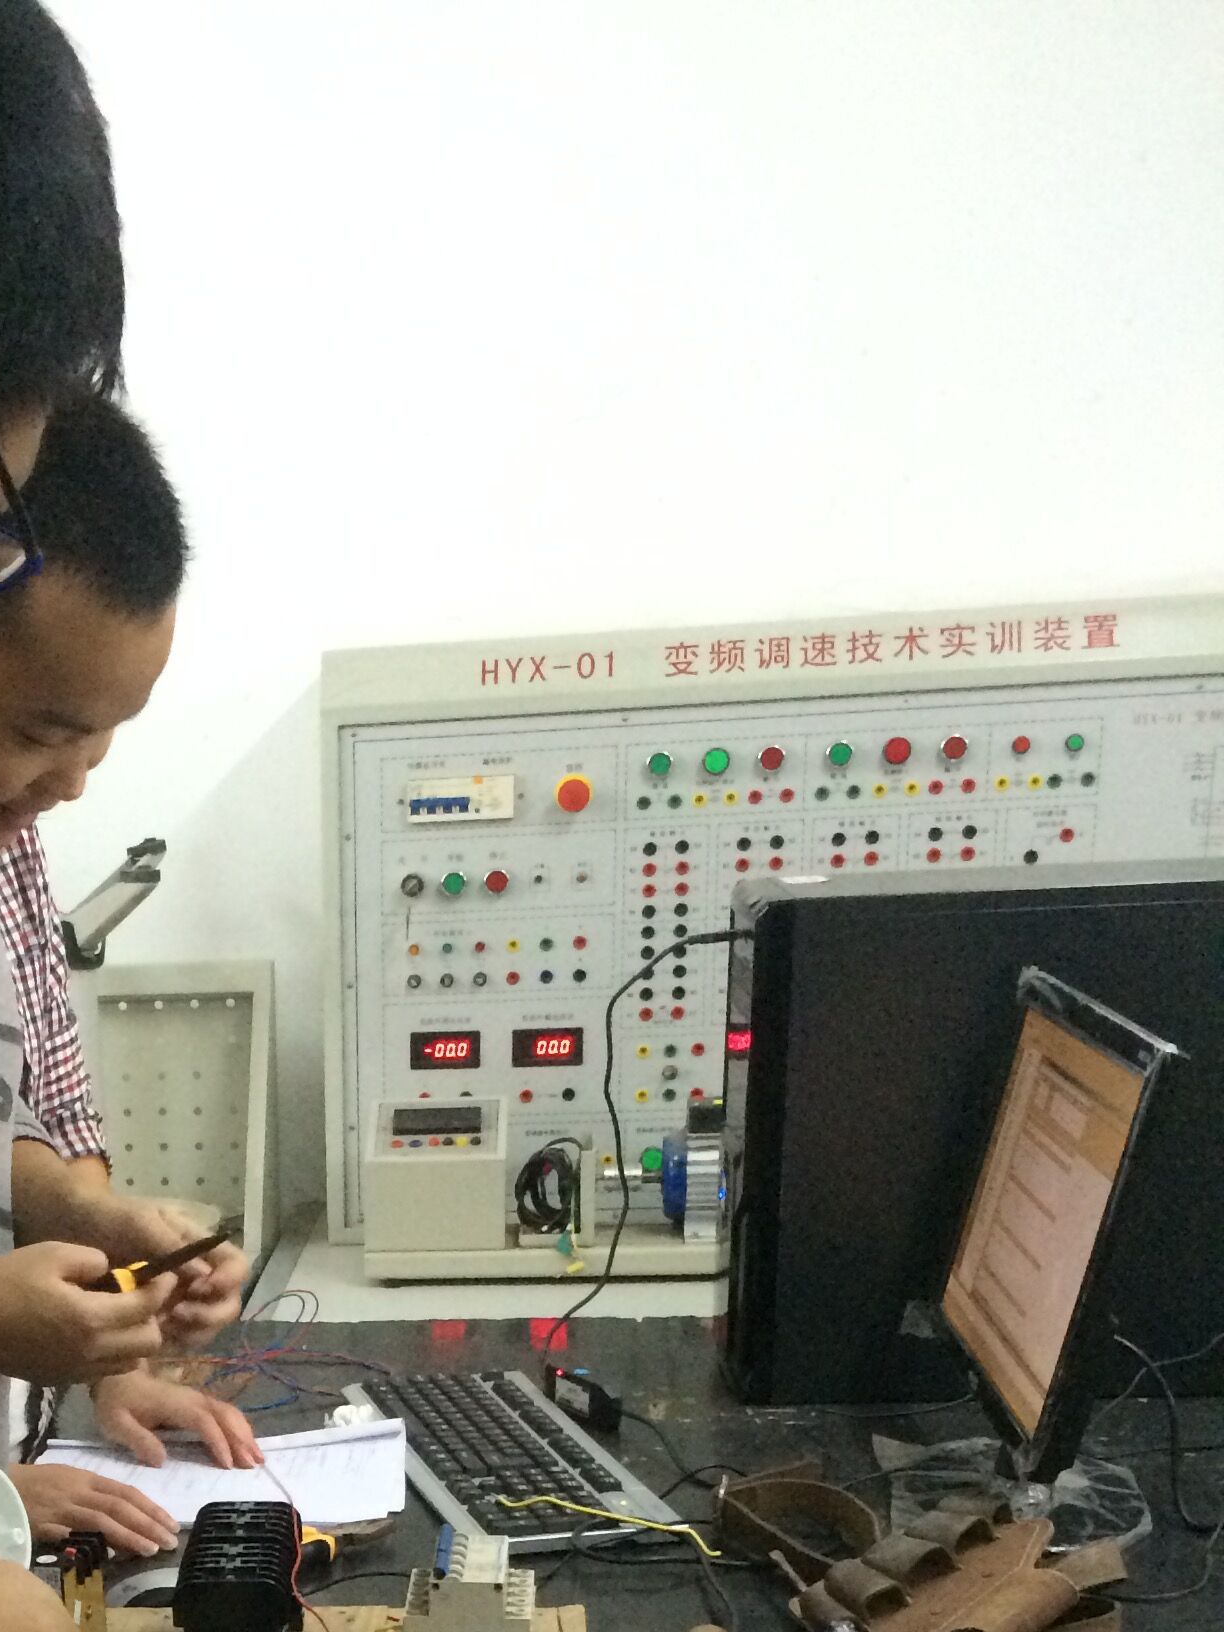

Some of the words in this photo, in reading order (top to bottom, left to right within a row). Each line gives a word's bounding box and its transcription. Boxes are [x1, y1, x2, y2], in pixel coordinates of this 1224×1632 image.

[480, 651, 615, 686] HYX-01
[664, 613, 1120, 678] 变频调速技术实训装置
